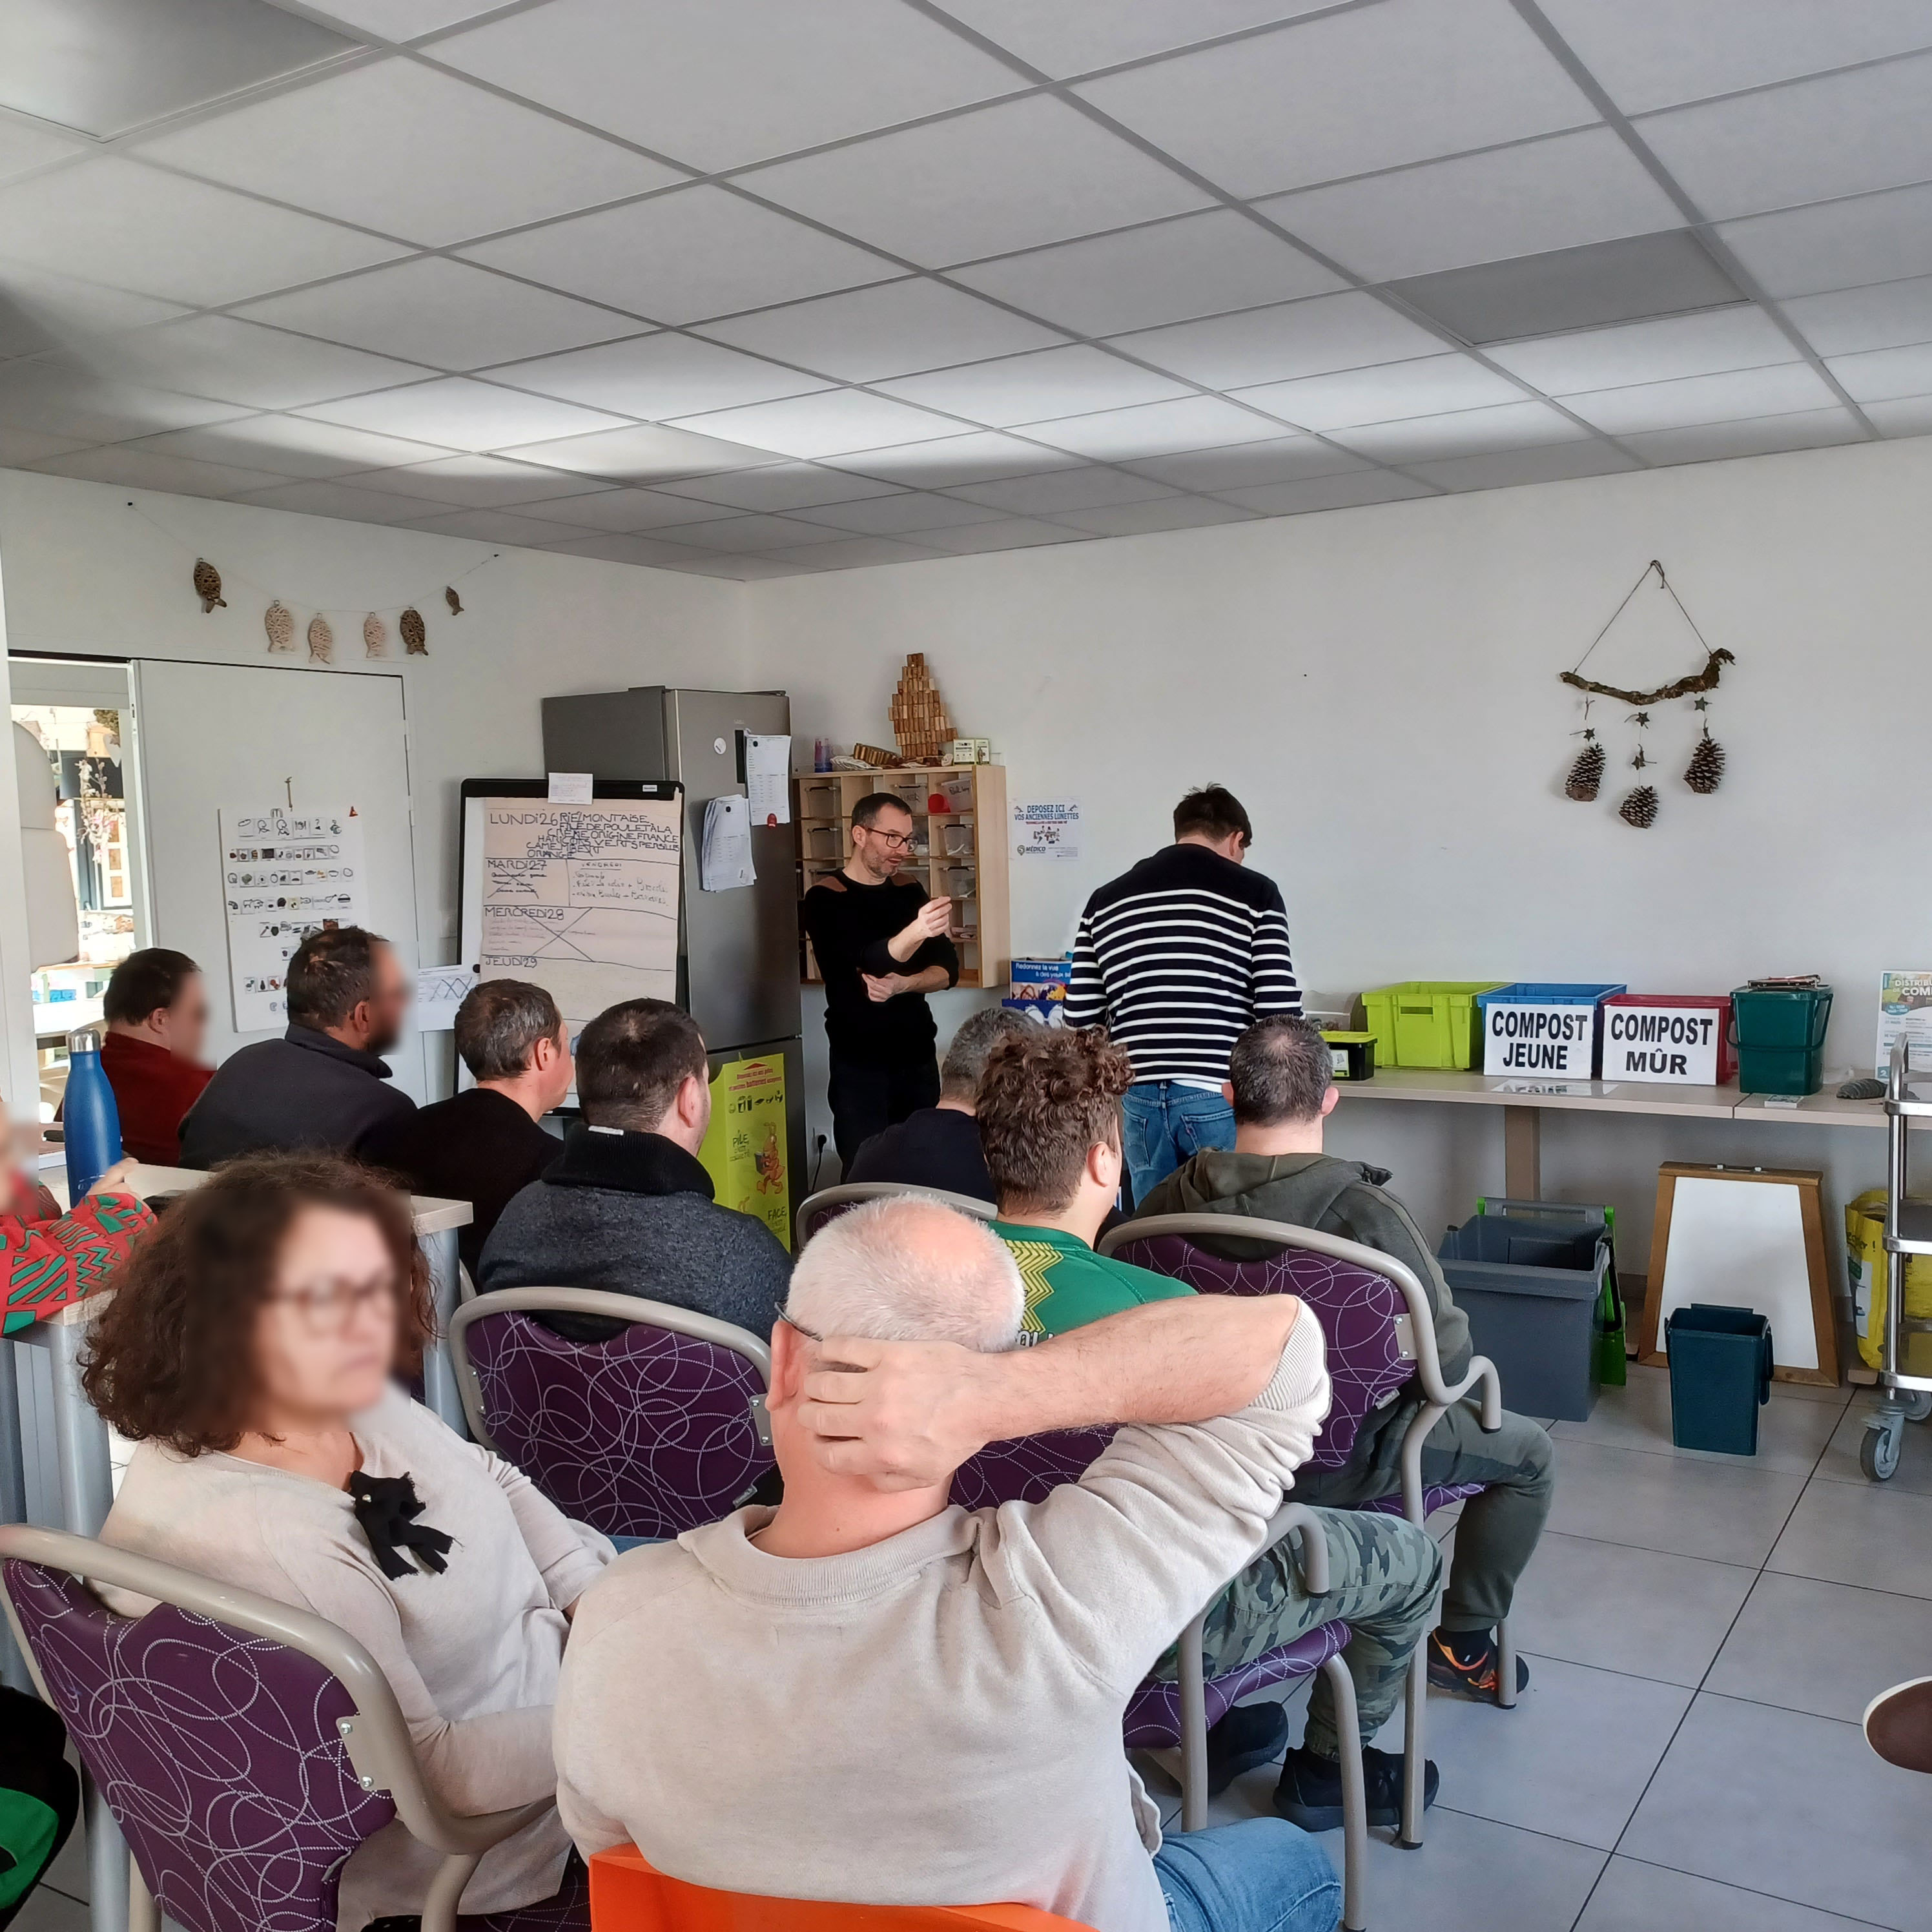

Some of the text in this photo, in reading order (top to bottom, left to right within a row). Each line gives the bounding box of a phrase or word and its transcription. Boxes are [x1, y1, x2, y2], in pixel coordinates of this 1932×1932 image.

[637, 833, 679, 843] FRANCE
[527, 849, 572, 858] ORANGE
[1902, 987, 1932, 996] COM
[1492, 1011, 1588, 1042] COMPOST
[1610, 1013, 1713, 1045] COMPOST
[1503, 1042, 1568, 1070] JEUNE
[1625, 1048, 1687, 1075] MÛR
